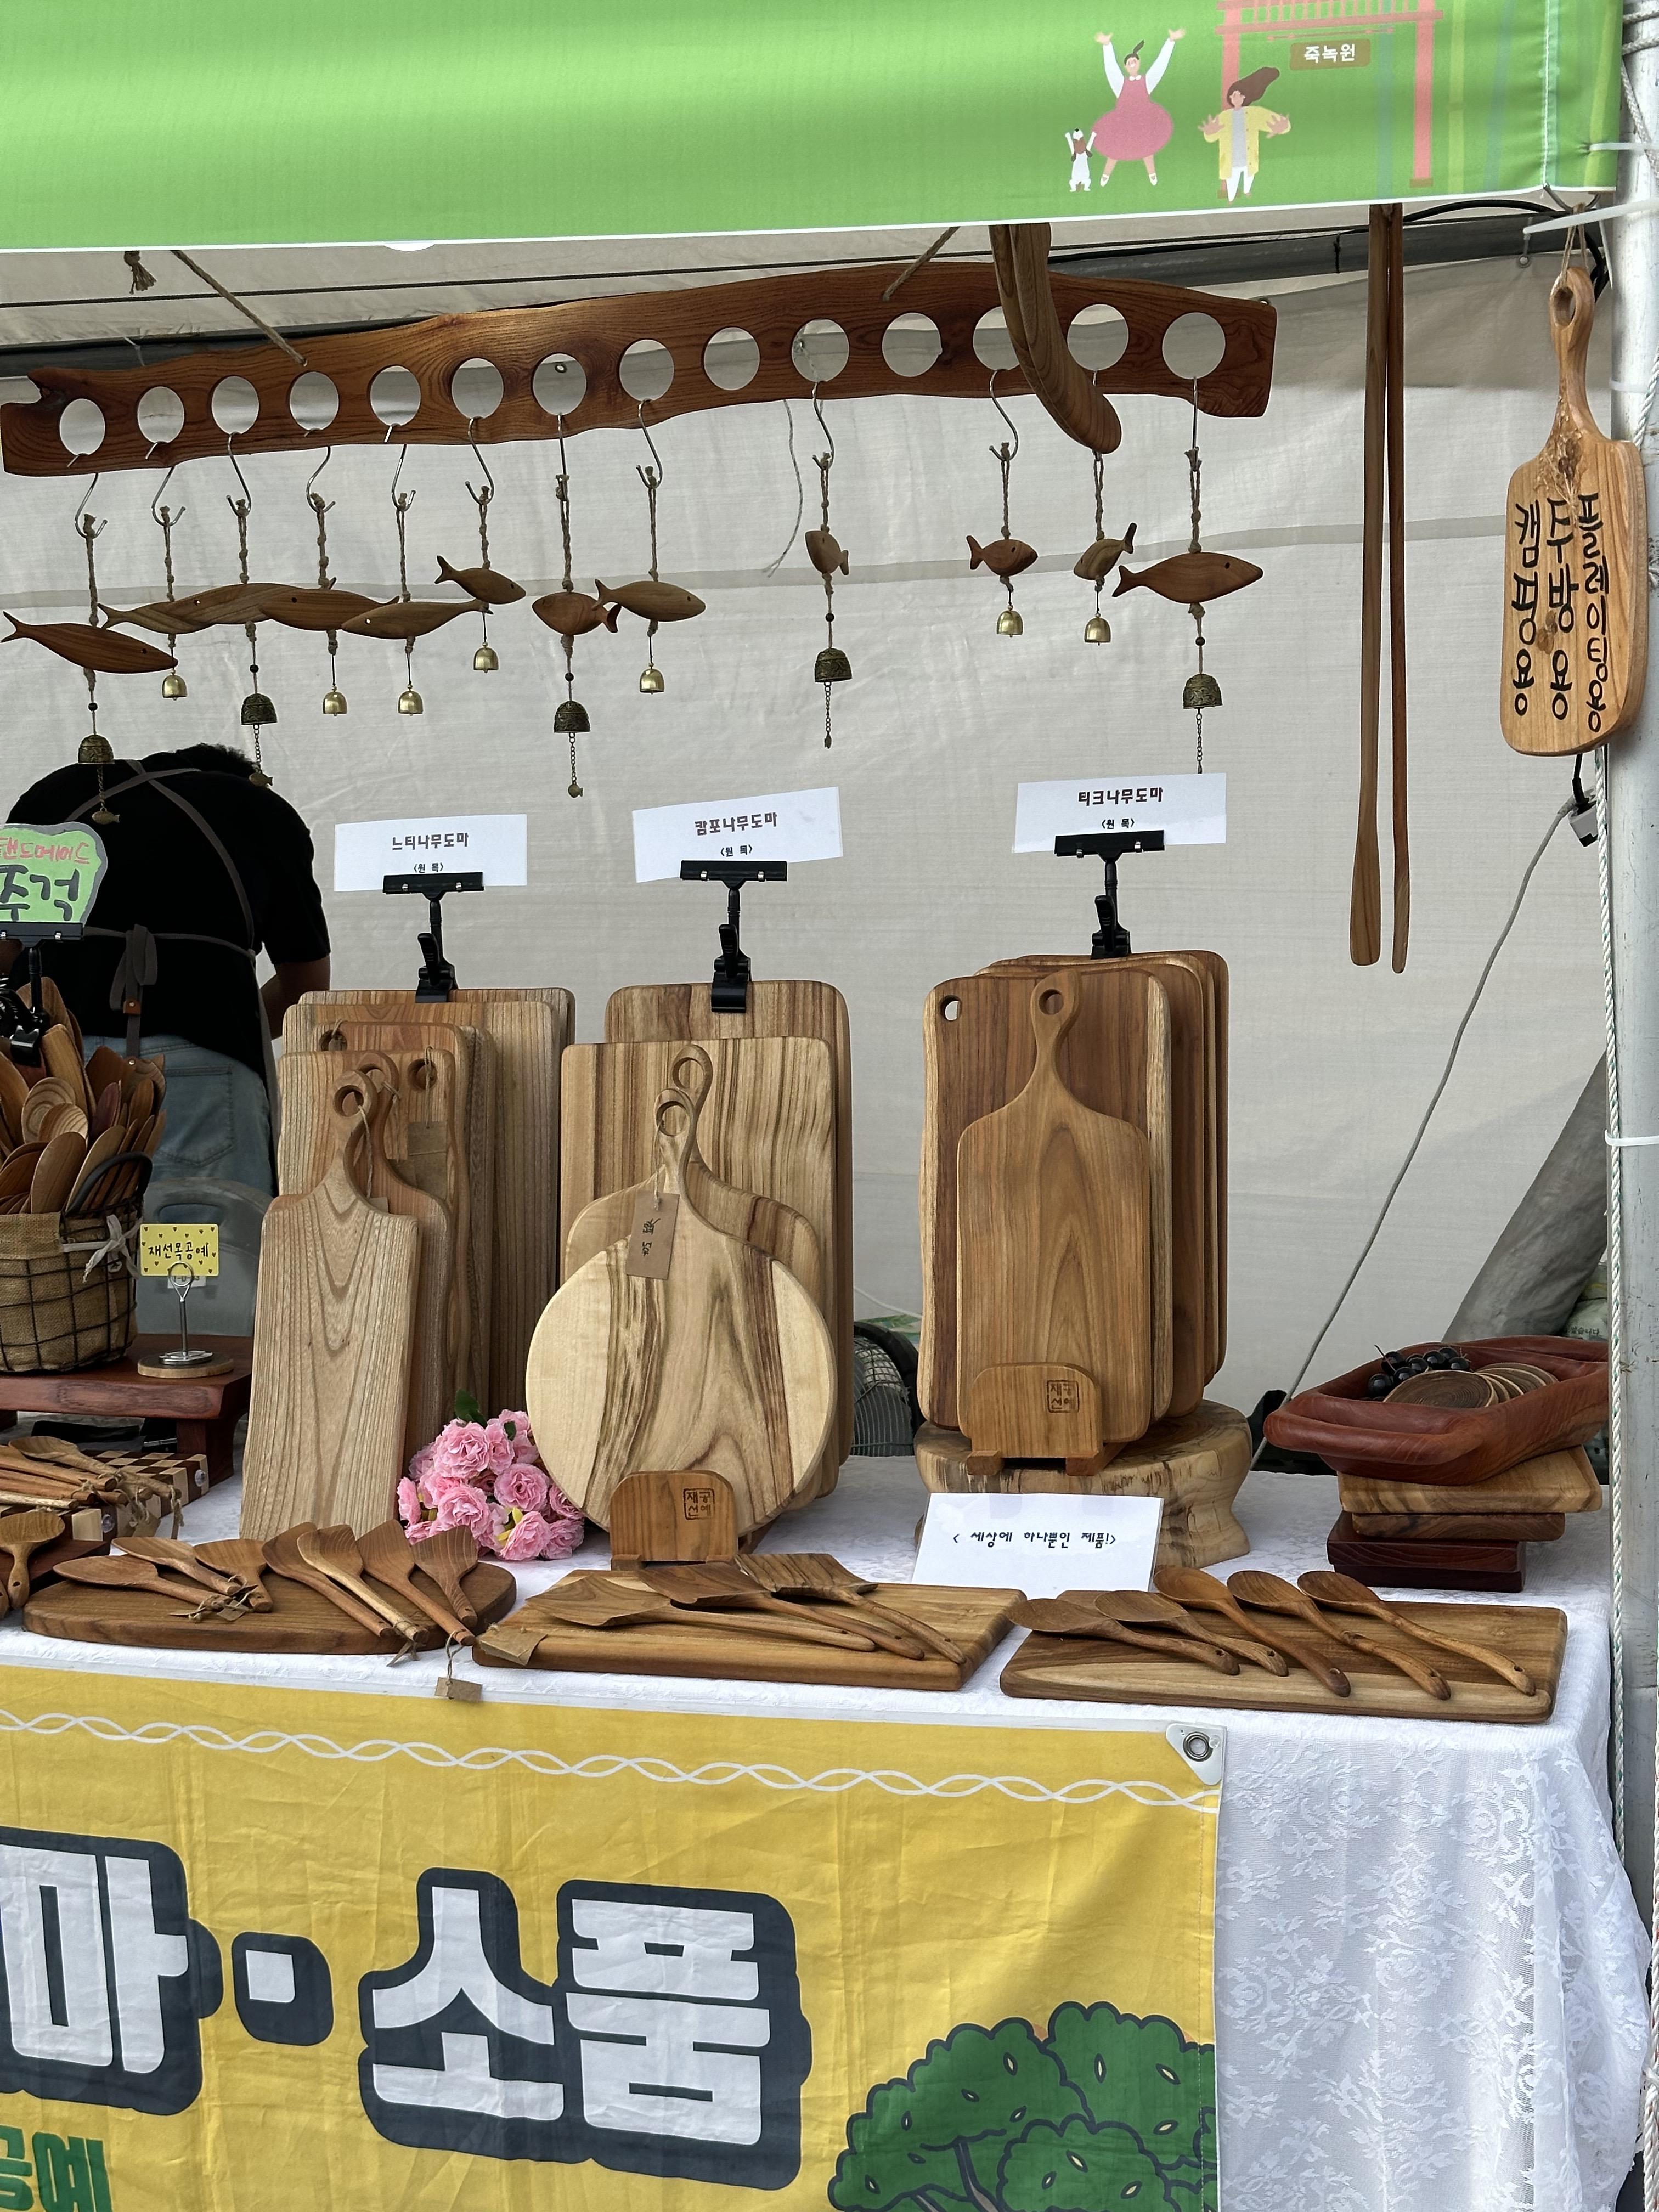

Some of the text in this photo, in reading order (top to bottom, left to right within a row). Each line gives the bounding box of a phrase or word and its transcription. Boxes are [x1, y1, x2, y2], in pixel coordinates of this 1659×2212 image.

[1304, 43, 1355, 63] 죽녹원
[1511, 499, 1541, 716] 캠핑용
[1578, 493, 1609, 732] 플레이팅용
[1078, 786, 1164, 806] 티크나무도마
[694, 811, 777, 836] 캄포나무도마
[392, 832, 469, 850] 느티나무도마
[148, 1241, 209, 1261] 재선목공예
[970, 1531, 1013, 1548] 세상에
[1024, 1531, 1070, 1549] 하나뿐인
